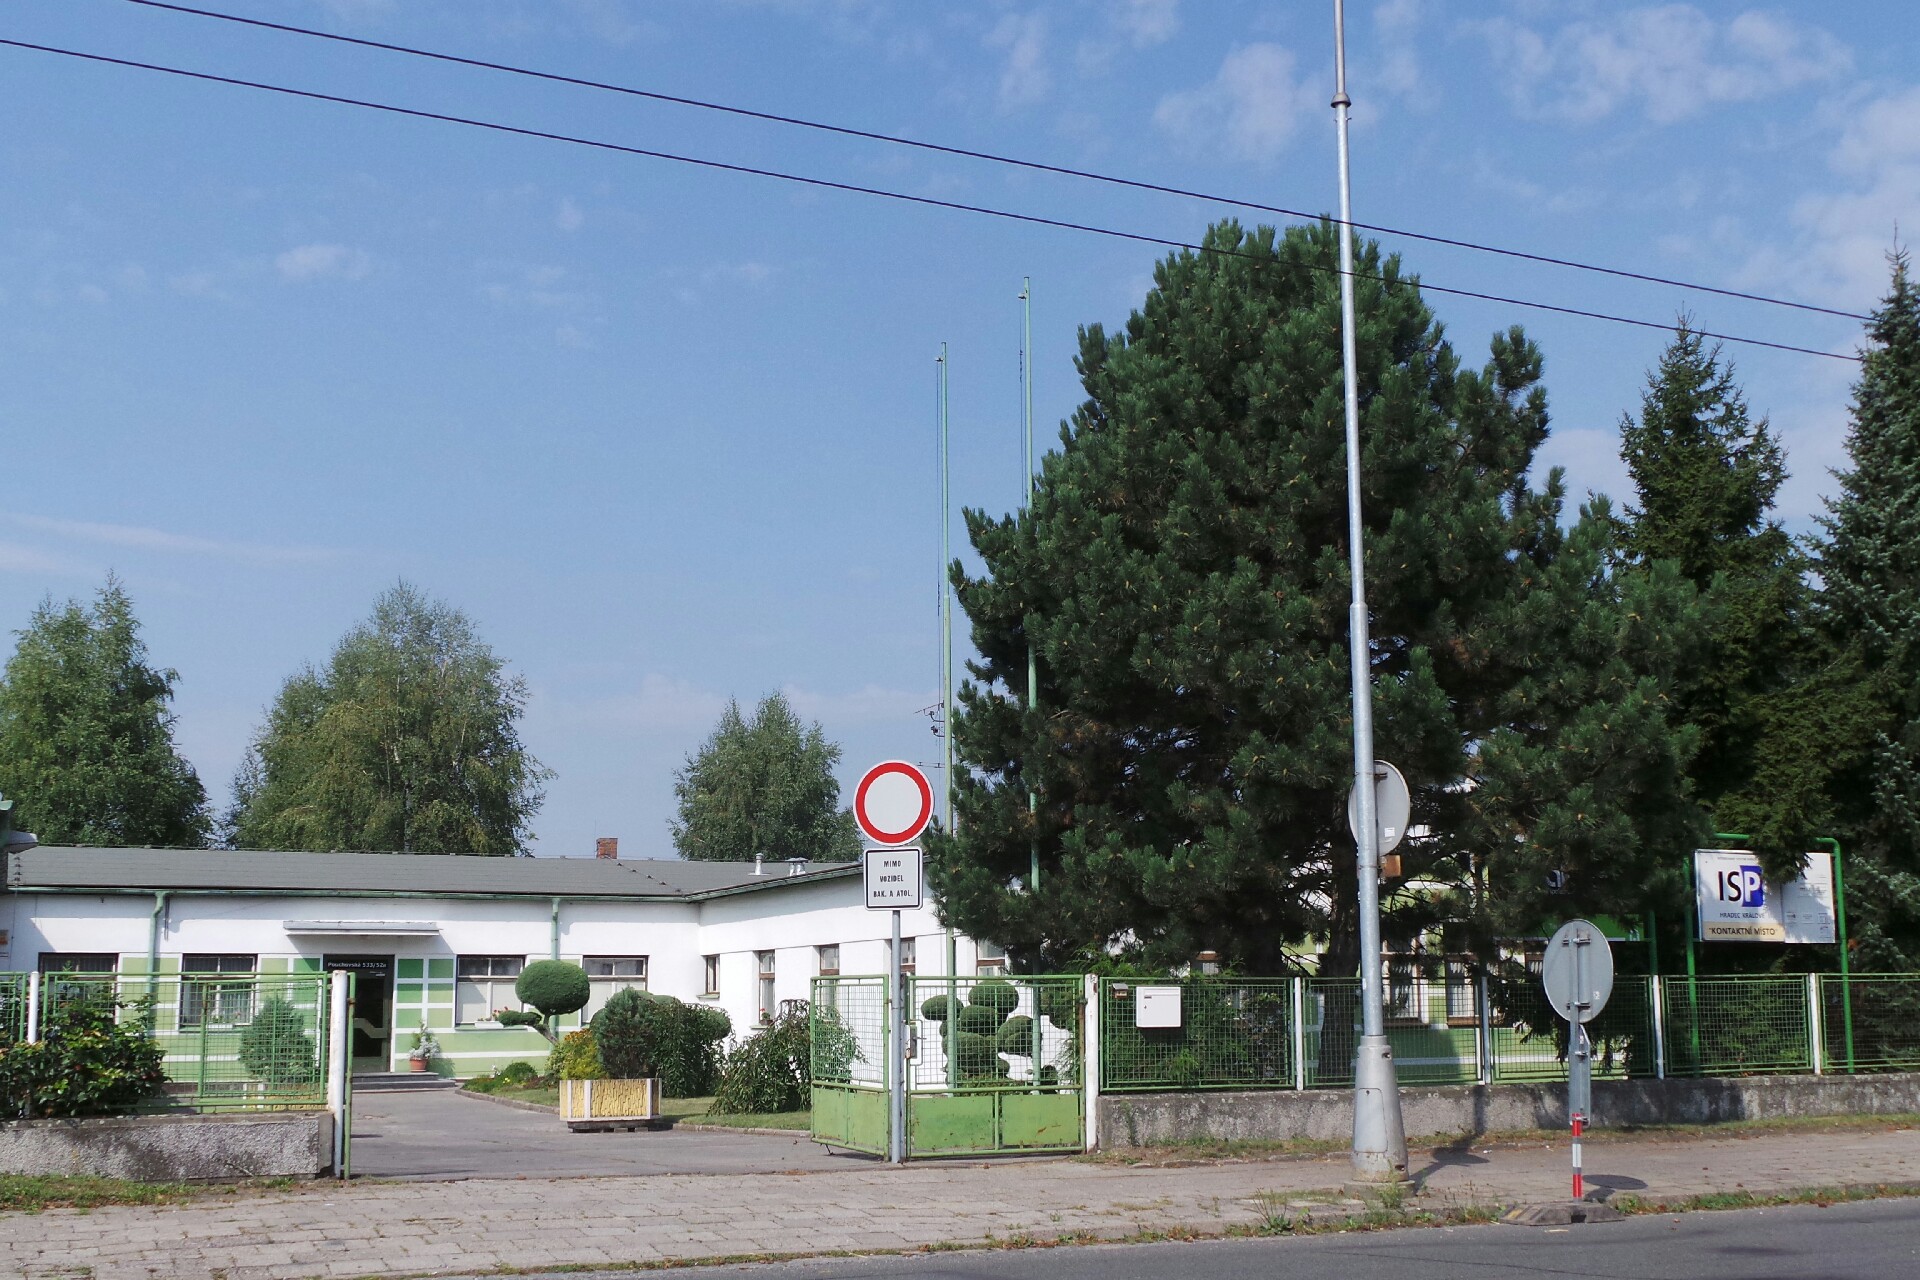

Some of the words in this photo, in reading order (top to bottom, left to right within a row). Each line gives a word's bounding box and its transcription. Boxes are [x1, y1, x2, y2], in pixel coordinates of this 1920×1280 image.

[883, 860, 902, 868] MIMO
[1718, 870, 1761, 902] ISP
[889, 890, 894, 898] A
